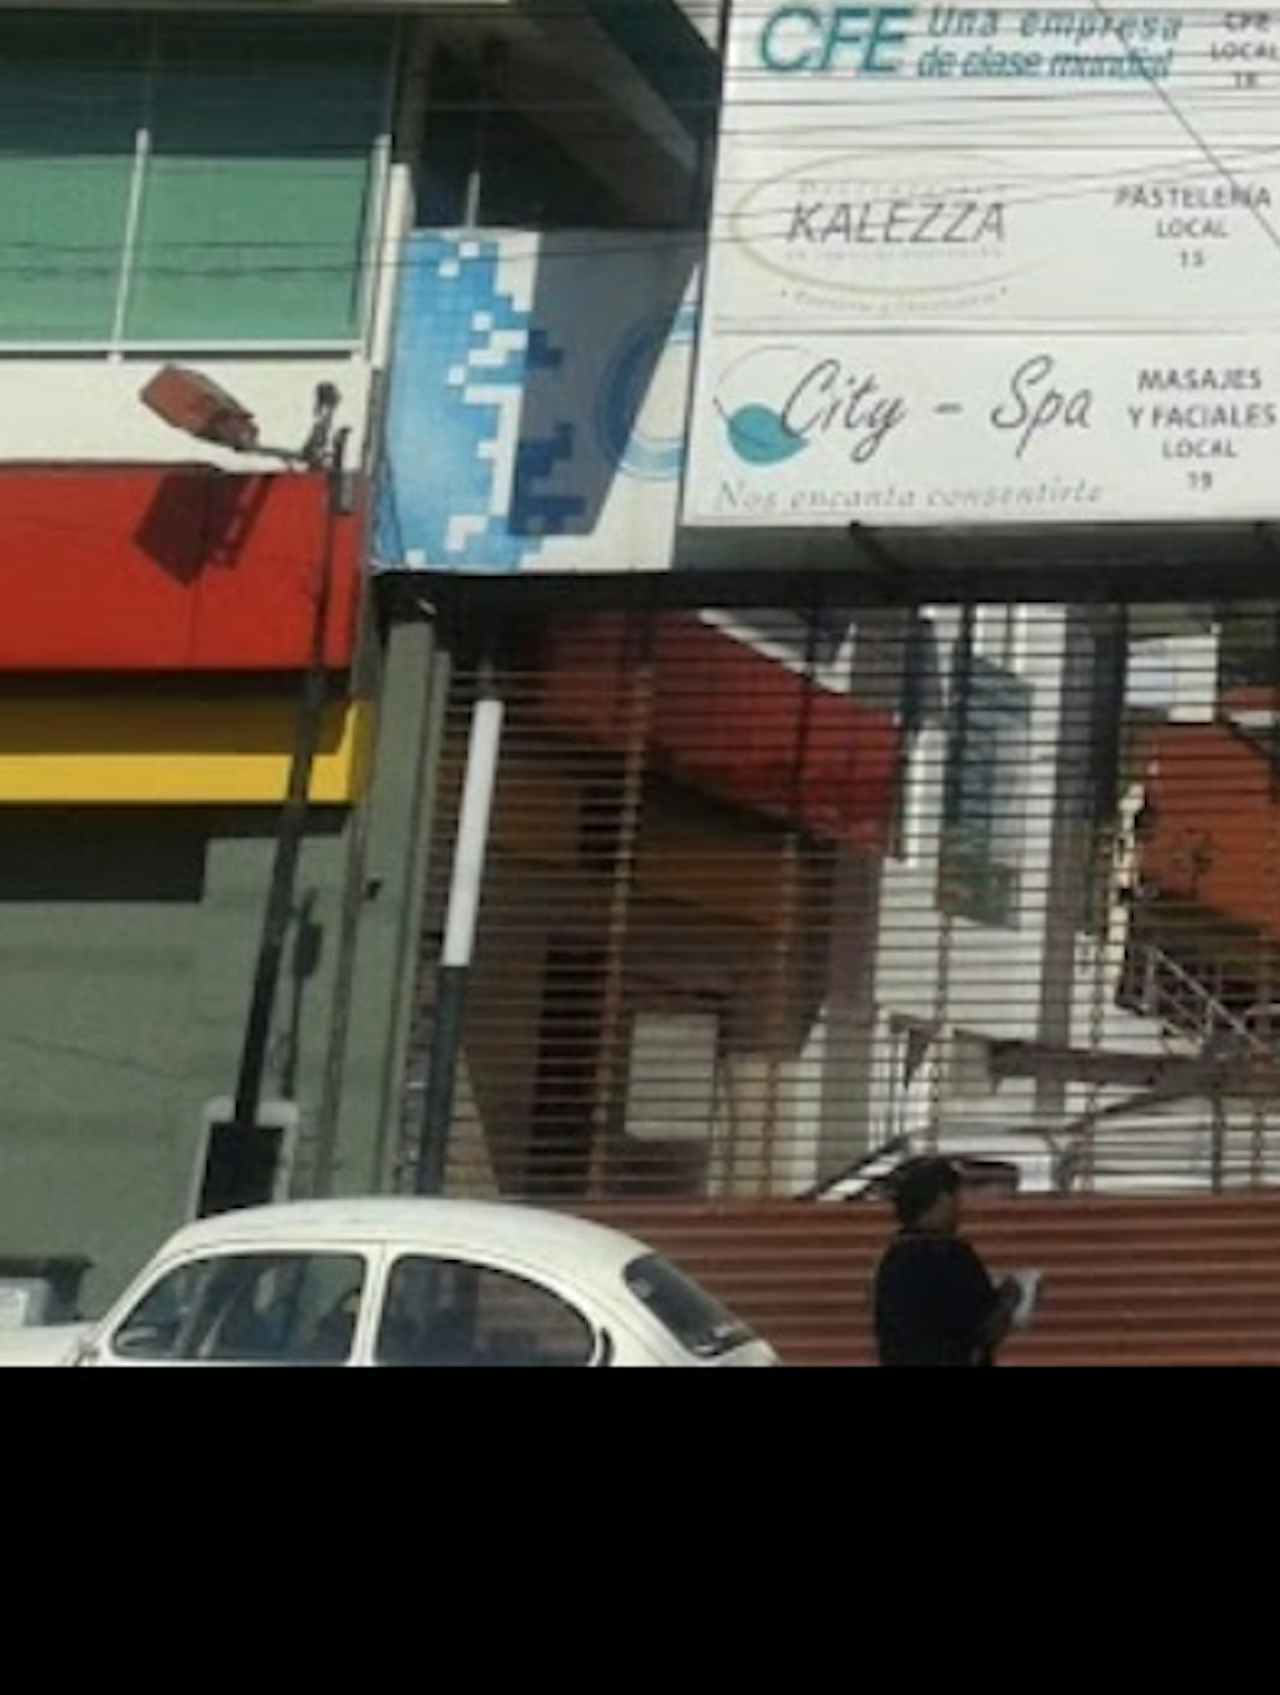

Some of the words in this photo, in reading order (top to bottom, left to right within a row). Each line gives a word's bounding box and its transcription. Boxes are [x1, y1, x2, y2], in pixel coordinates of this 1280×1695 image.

[759, 2, 915, 73] CFE
[926, 4, 998, 37] Una
[1019, 10, 1182, 45] empresa
[918, 46, 953, 78] de
[1210, 43, 1280, 62] LOCAL
[787, 202, 1005, 243] KALEZZA
[1155, 218, 1229, 238] LOCAL
[1137, 367, 1264, 393] MASAJES
[781, 359, 908, 463] City
[991, 354, 1094, 461] Spa
[1128, 403, 1147, 429] Y
[1151, 402, 1278, 429] FACIALES
[1162, 438, 1237, 459] LOCAL
[718, 479, 780, 513] Nos
[790, 480, 916, 510] encanta
